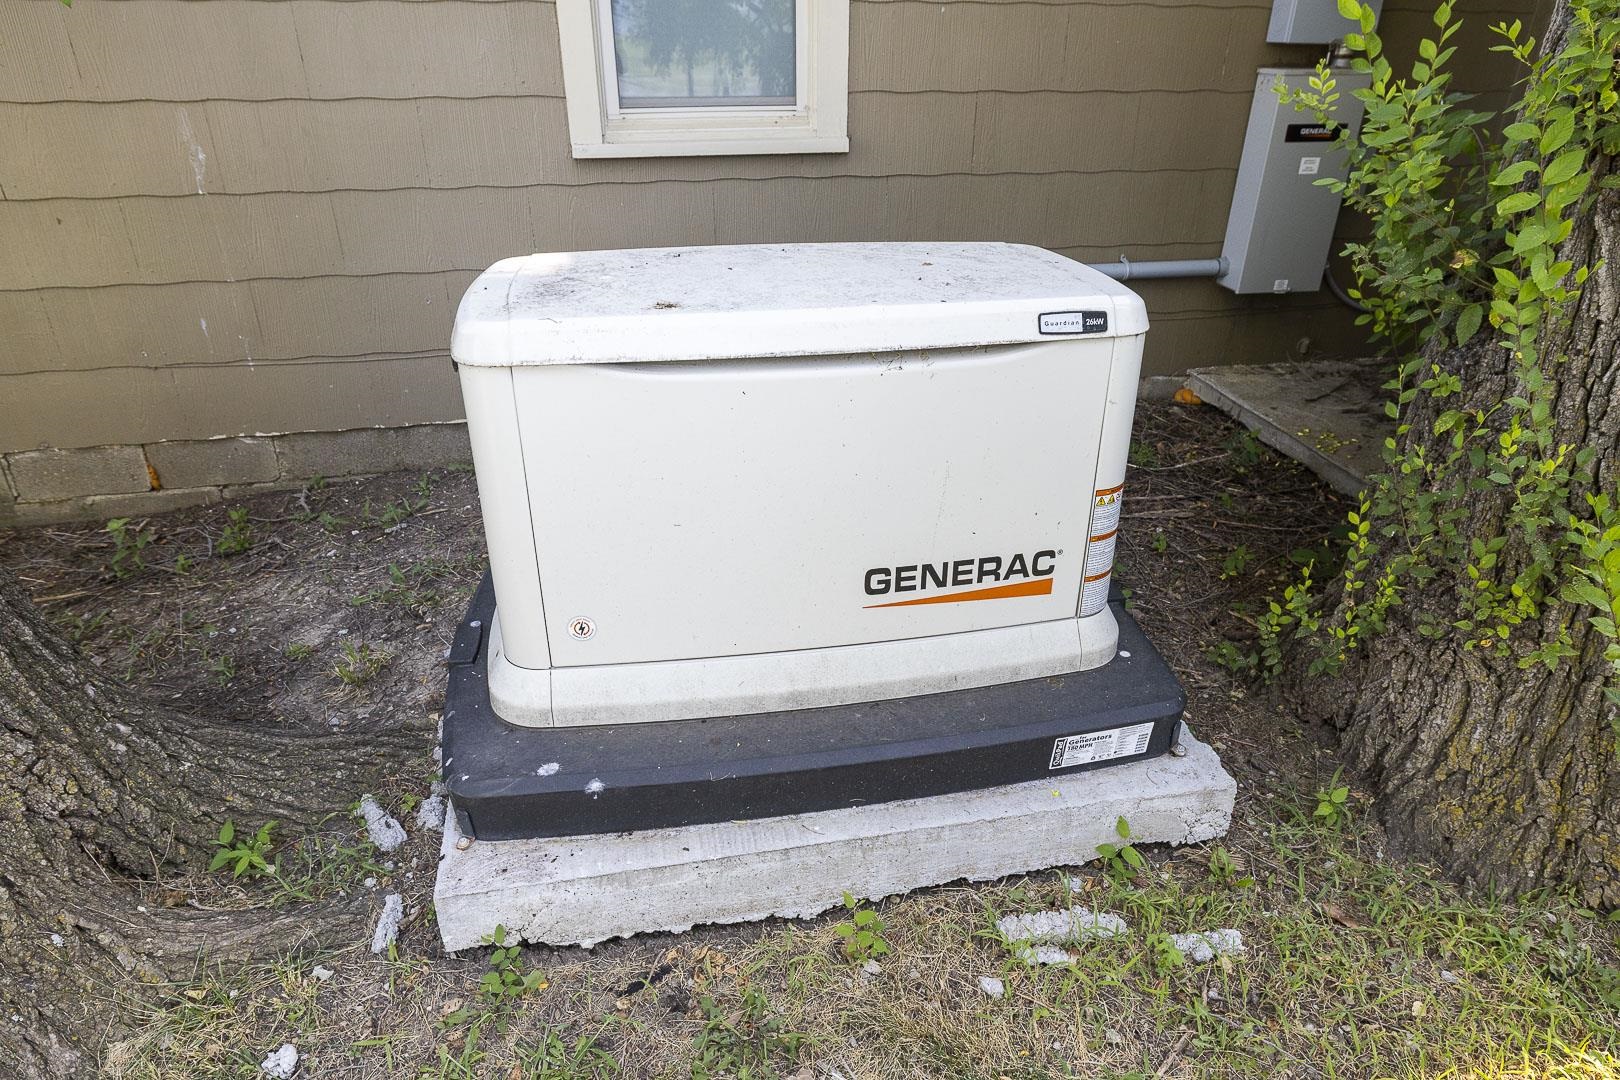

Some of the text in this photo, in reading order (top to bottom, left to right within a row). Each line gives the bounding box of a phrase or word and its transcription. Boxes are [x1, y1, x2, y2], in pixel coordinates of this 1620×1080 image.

[1085, 317, 1104, 325] 26kW
[864, 549, 1056, 596] GENERAC
[1069, 734, 1112, 745] Generators
